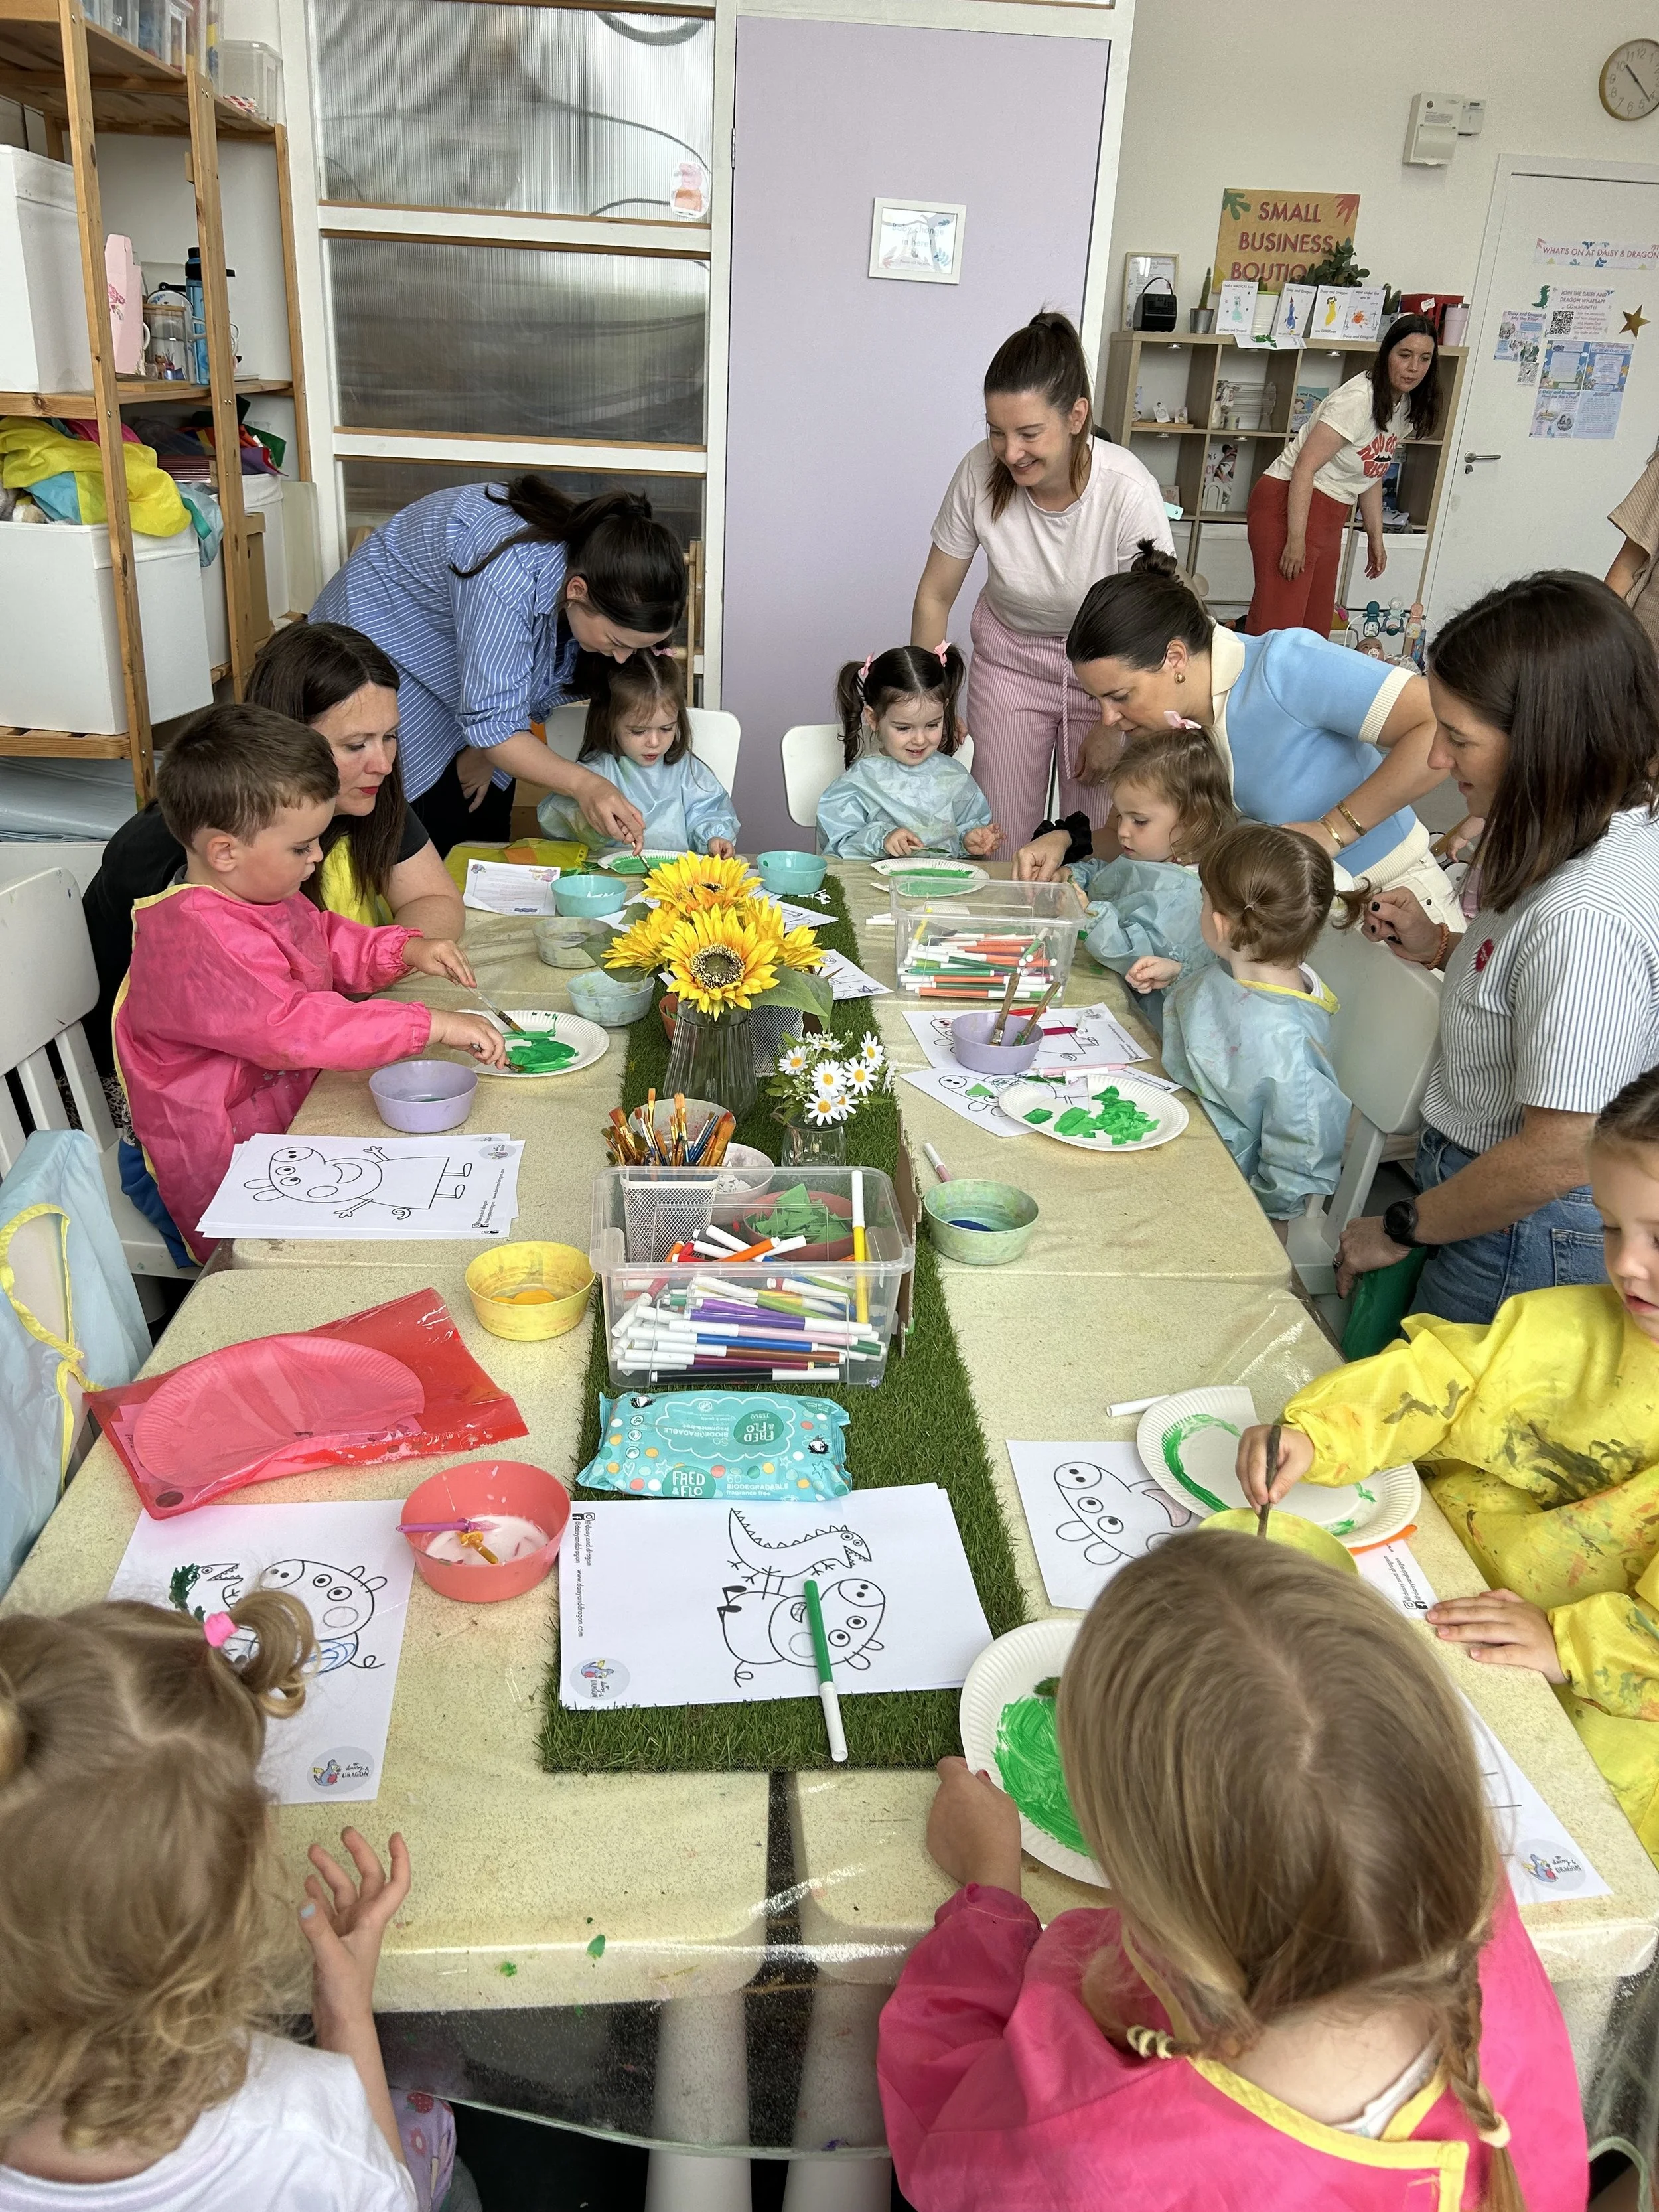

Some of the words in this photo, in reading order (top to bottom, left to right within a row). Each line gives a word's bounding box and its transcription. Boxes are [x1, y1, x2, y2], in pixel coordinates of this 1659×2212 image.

[1626, 51, 1634, 62] 11
[1636, 48, 1646, 60] 12
[1650, 52, 1654, 63] 1
[1616, 60, 1626, 72] 10
[1609, 74, 1616, 84] 9
[1610, 86, 1617, 98] 8
[1615, 97, 1624, 110] 7
[1626, 101, 1634, 112] 6
[1638, 98, 1645, 109] 5
[1258, 201, 1321, 224] SMALL
[892, 223, 912, 236] Baby
[912, 224, 944, 237] change
[911, 236, 932, 247] here!
[1238, 232, 1334, 254] BUSINESS
[1543, 246, 1569, 255] WHAT'S
[663, 1427, 729, 1438] BIODEGRADABLE
[747, 1422, 767, 1433] FLO
[744, 1430, 774, 1442] FRED
[672, 1470, 705, 1486] FRED
[727, 1474, 742, 1484] 60
[672, 1487, 680, 1495] &
[680, 1485, 703, 1497] FLO
[576, 1568, 585, 1637] www.daisyanddragon.com
[1555, 1865, 1581, 1874] DRAGON
